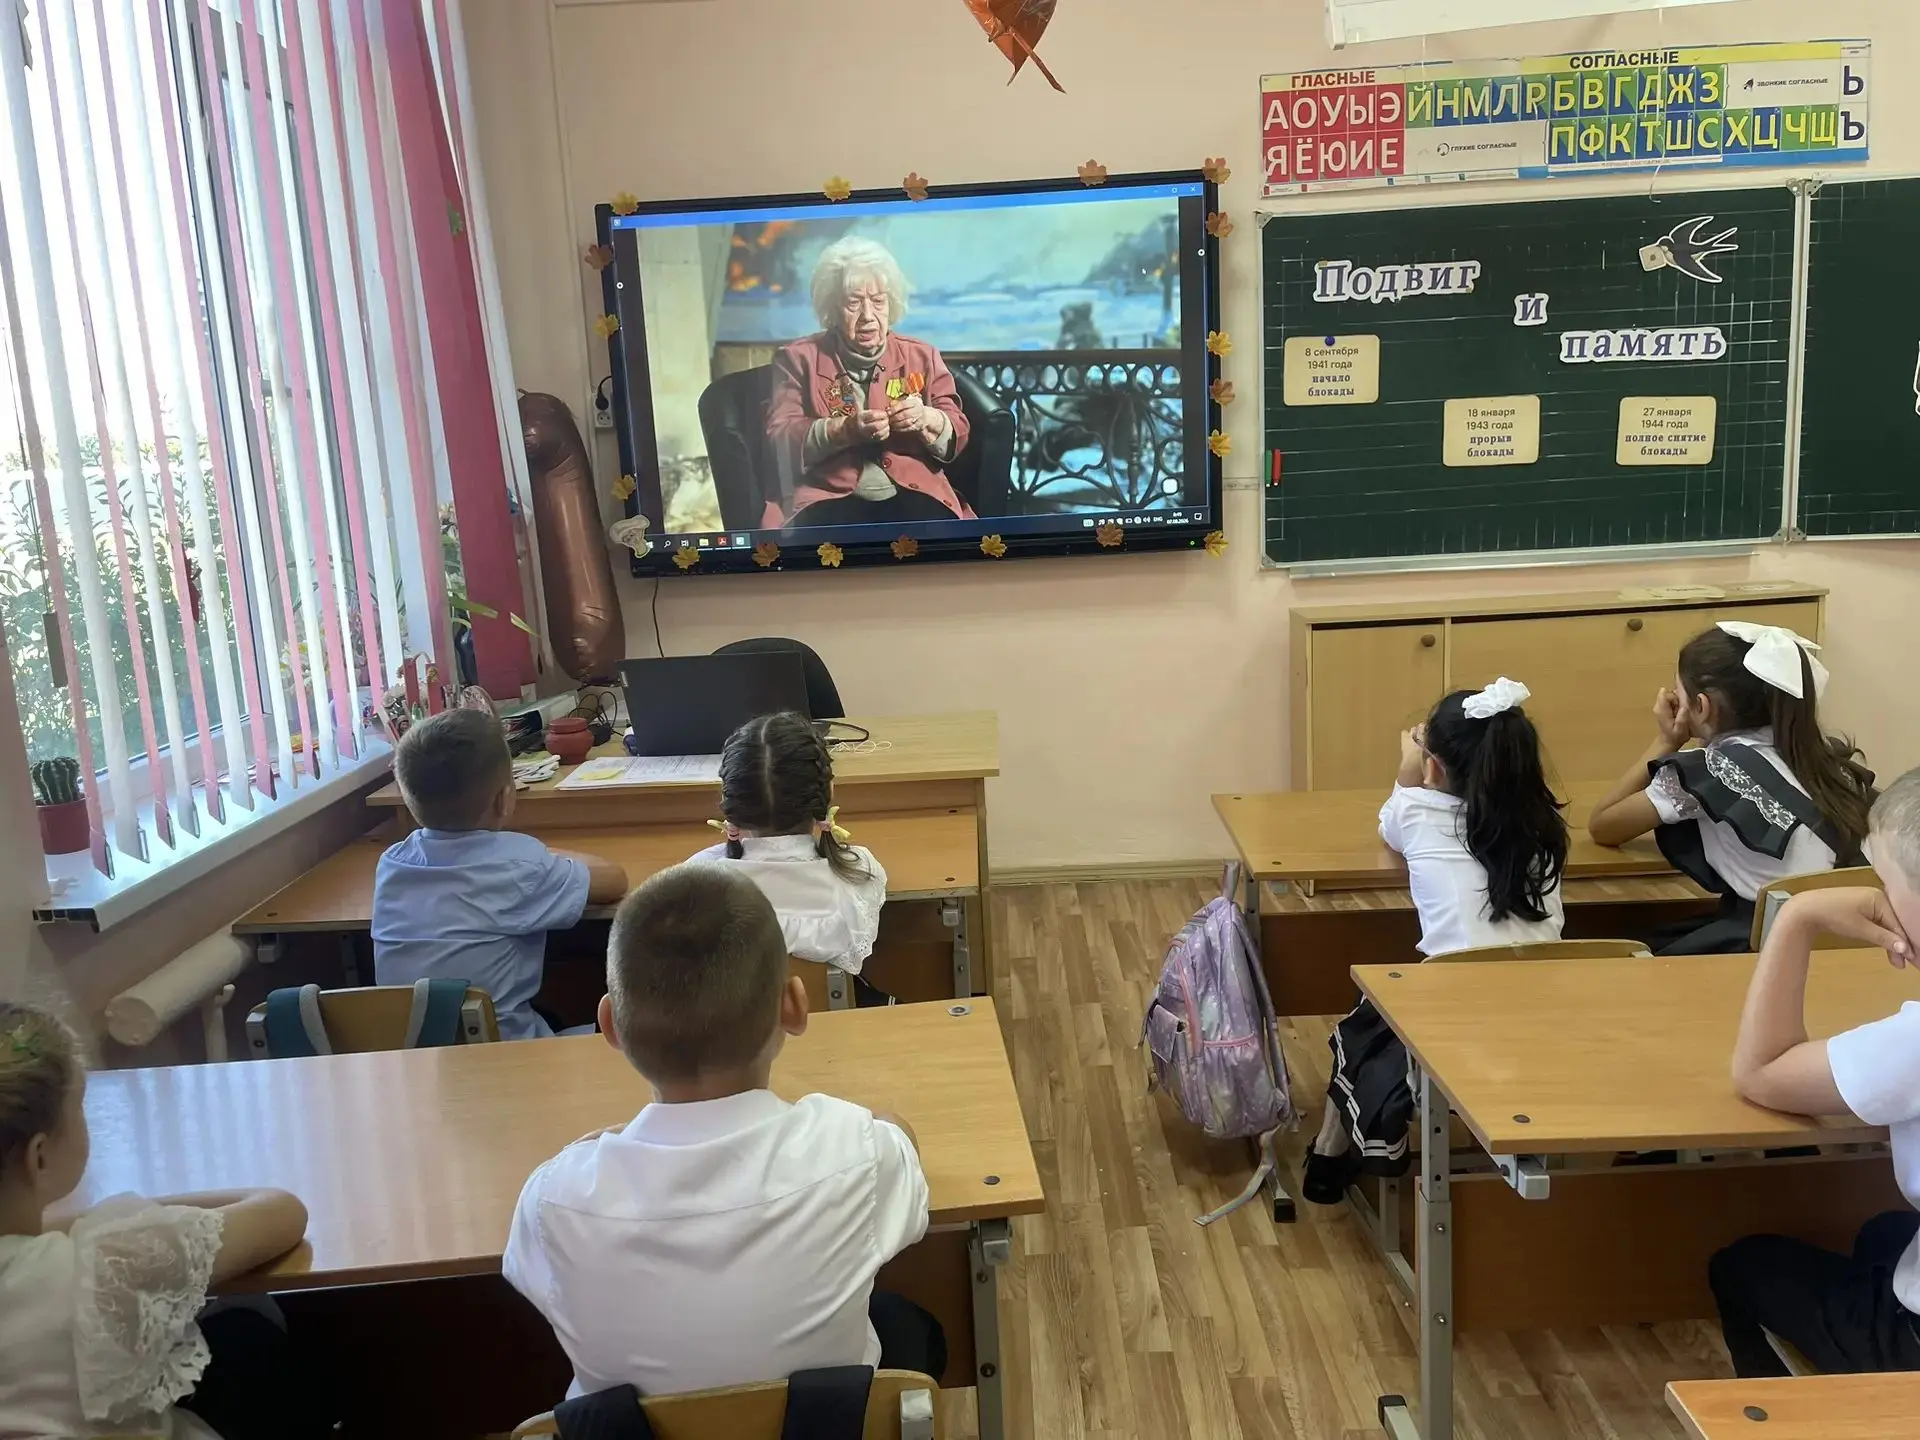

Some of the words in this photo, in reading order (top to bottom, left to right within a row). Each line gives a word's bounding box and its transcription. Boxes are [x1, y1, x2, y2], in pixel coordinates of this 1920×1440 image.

[1570, 51, 1679, 69] СОГЛАСНЫЕ
[1292, 71, 1375, 88] ГЛАСНЫЕ
[1477, 142, 1517, 150] СОГЛАСНЫЕ
[1317, 264, 1477, 298] Подвиг
[1519, 298, 1543, 321] и
[1564, 331, 1723, 359] память
[1305, 348, 1311, 356] 8
[1314, 347, 1359, 357] сентября
[1308, 361, 1328, 369] 1941
[1331, 361, 1352, 369] года
[1312, 375, 1350, 383] начало
[1308, 387, 1354, 396] блокады
[1468, 409, 1478, 417] 18
[1481, 409, 1516, 417] января
[1643, 408, 1655, 416] 27
[1657, 409, 1692, 417] января
[1467, 421, 1489, 430] 1943
[1492, 422, 1513, 430] года
[1642, 420, 1663, 428] 1944
[1666, 420, 1689, 428] года
[1470, 435, 1512, 445] прорыв
[1668, 434, 1707, 442] снятие
[1467, 448, 1514, 457] блокады
[1641, 446, 1687, 456] блокады
